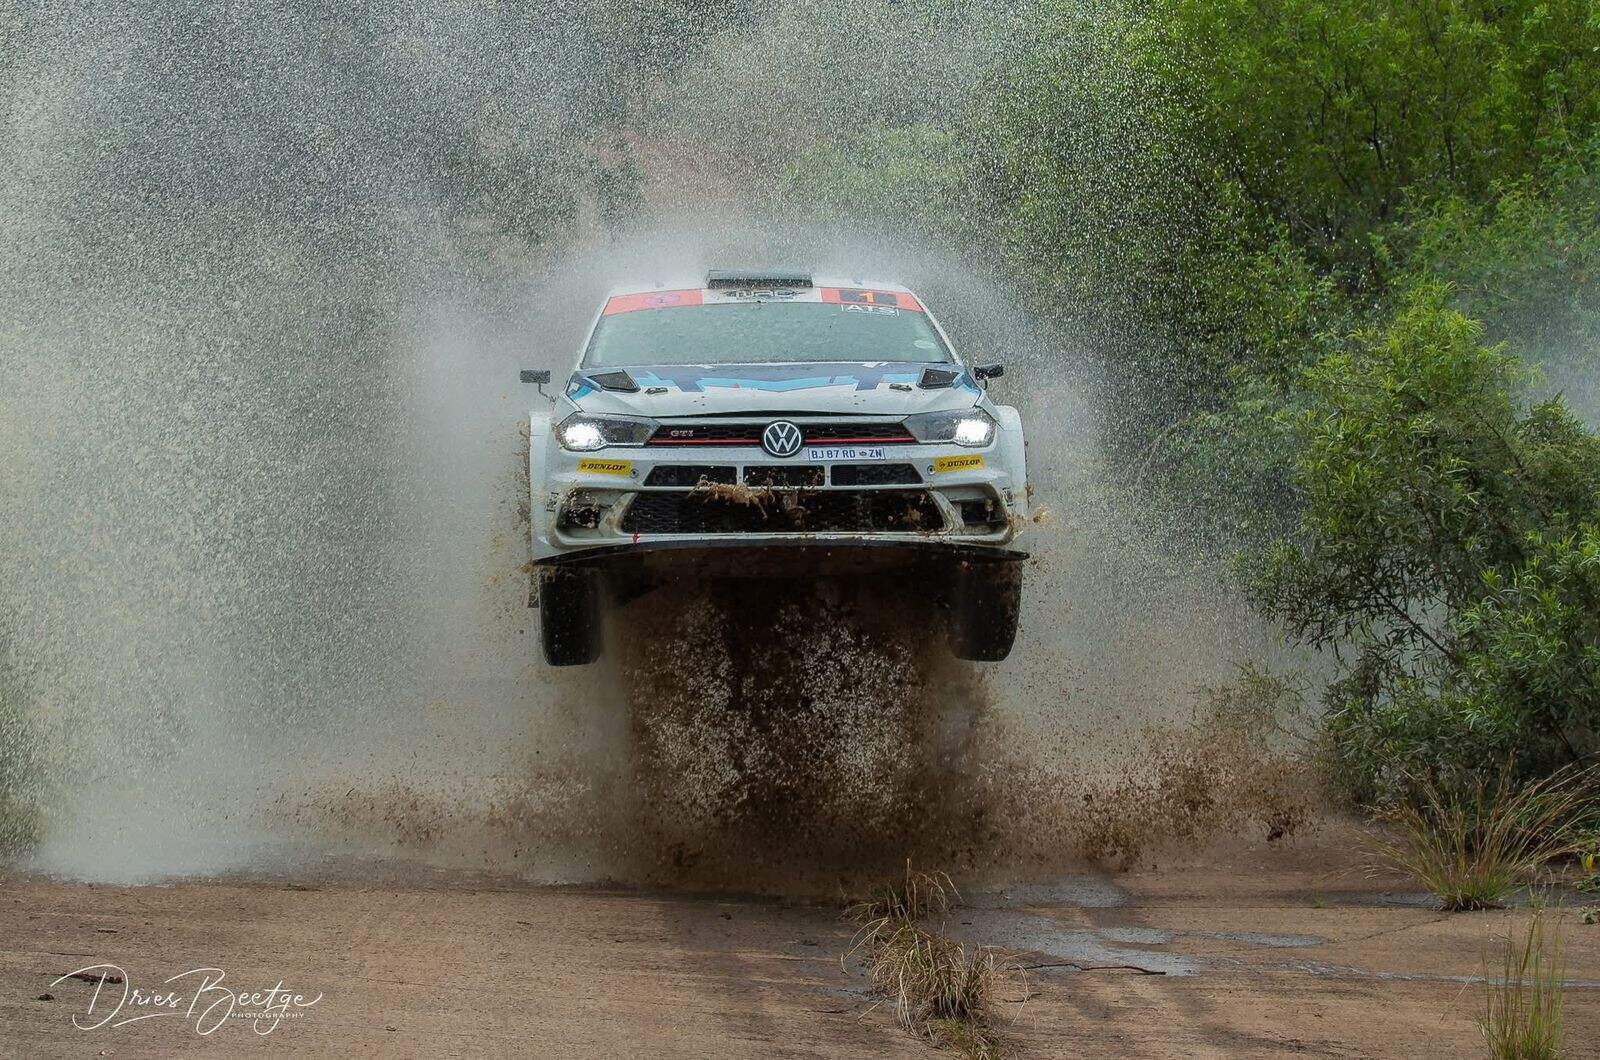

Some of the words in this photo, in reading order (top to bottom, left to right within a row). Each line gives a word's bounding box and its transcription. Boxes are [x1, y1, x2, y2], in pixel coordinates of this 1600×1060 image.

[862, 290, 874, 303] 1
[811, 449, 824, 459] BJ
[826, 449, 839, 458] 87
[868, 449, 882, 458] ZN
[587, 463, 627, 472] DUNLOP
[946, 458, 981, 468] DUNLOP
